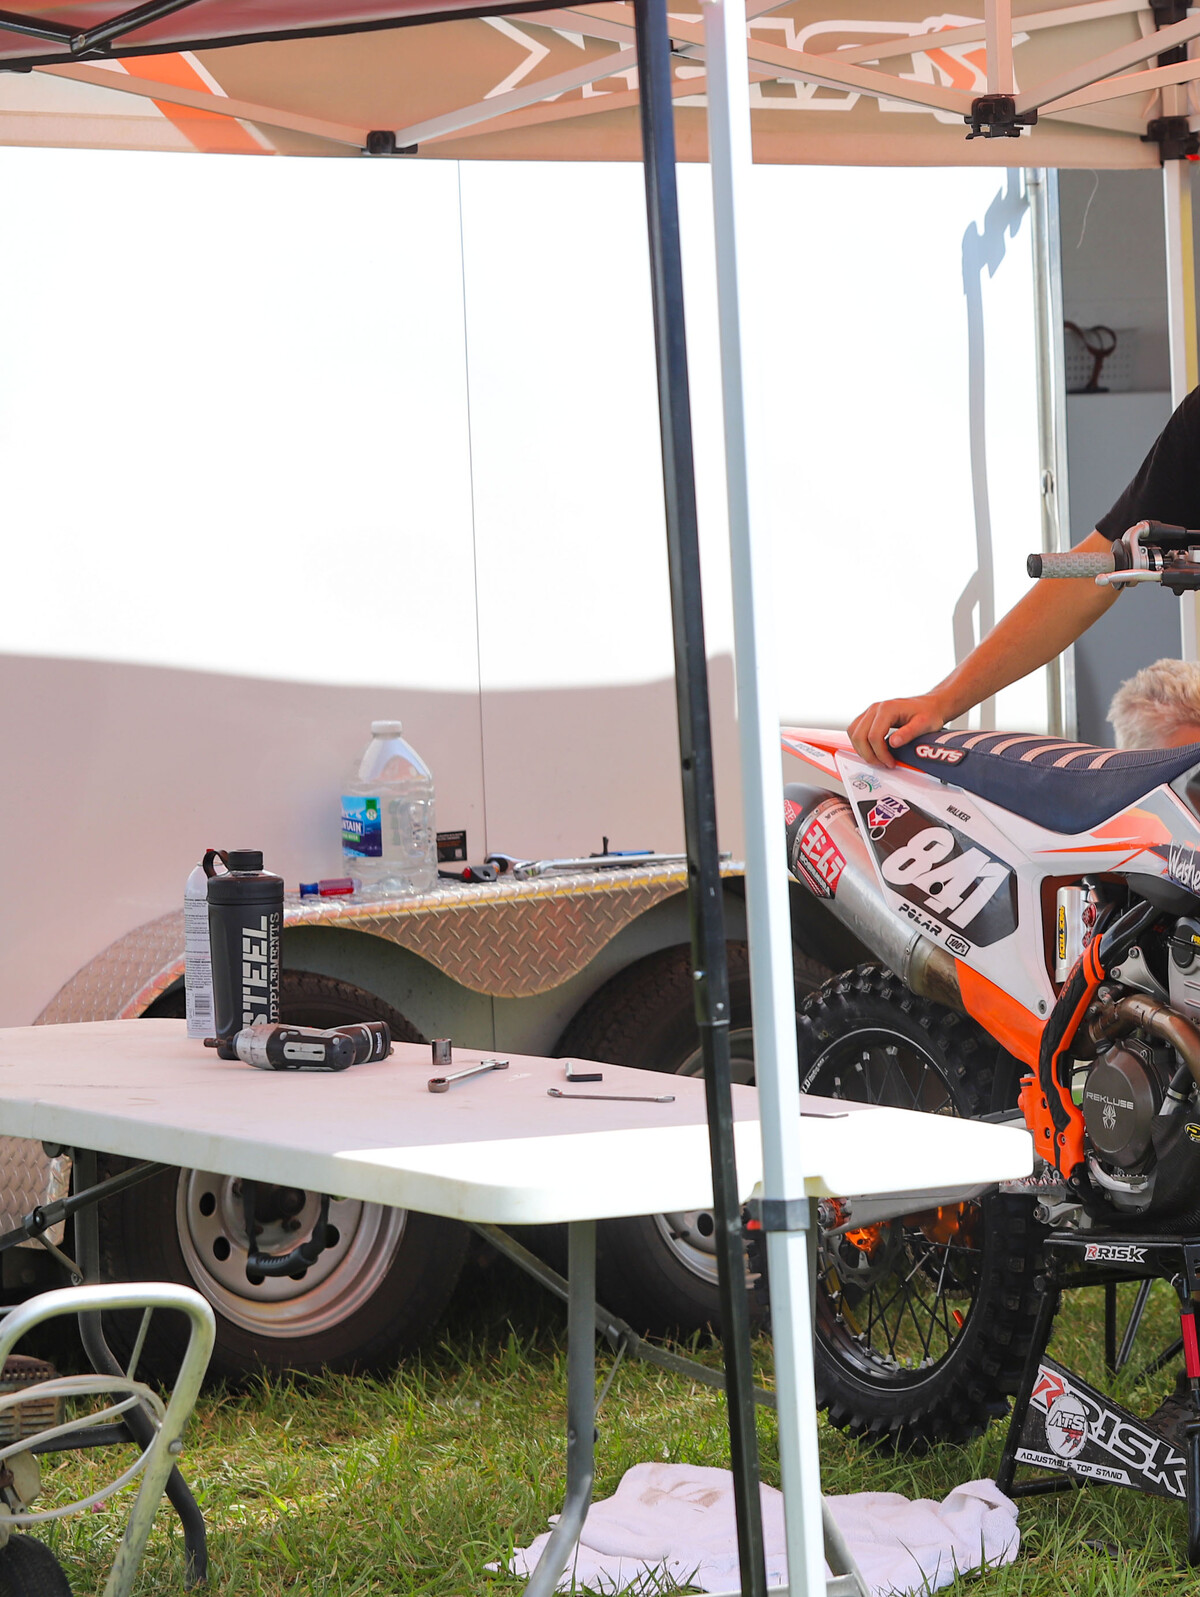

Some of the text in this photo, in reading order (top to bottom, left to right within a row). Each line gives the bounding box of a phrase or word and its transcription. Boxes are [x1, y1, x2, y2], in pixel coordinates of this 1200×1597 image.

[916, 745, 963, 763] GUTS
[882, 796, 908, 813] MX
[946, 804, 971, 823] WALKER
[881, 827, 1012, 930] 841
[898, 903, 943, 936] POLAR
[949, 938, 967, 953] 100%
[243, 915, 268, 1029] STEEL
[1086, 1091, 1134, 1110] REKLUSE
[1020, 1452, 1122, 1480] ADJUSTABLE TOP STAND
